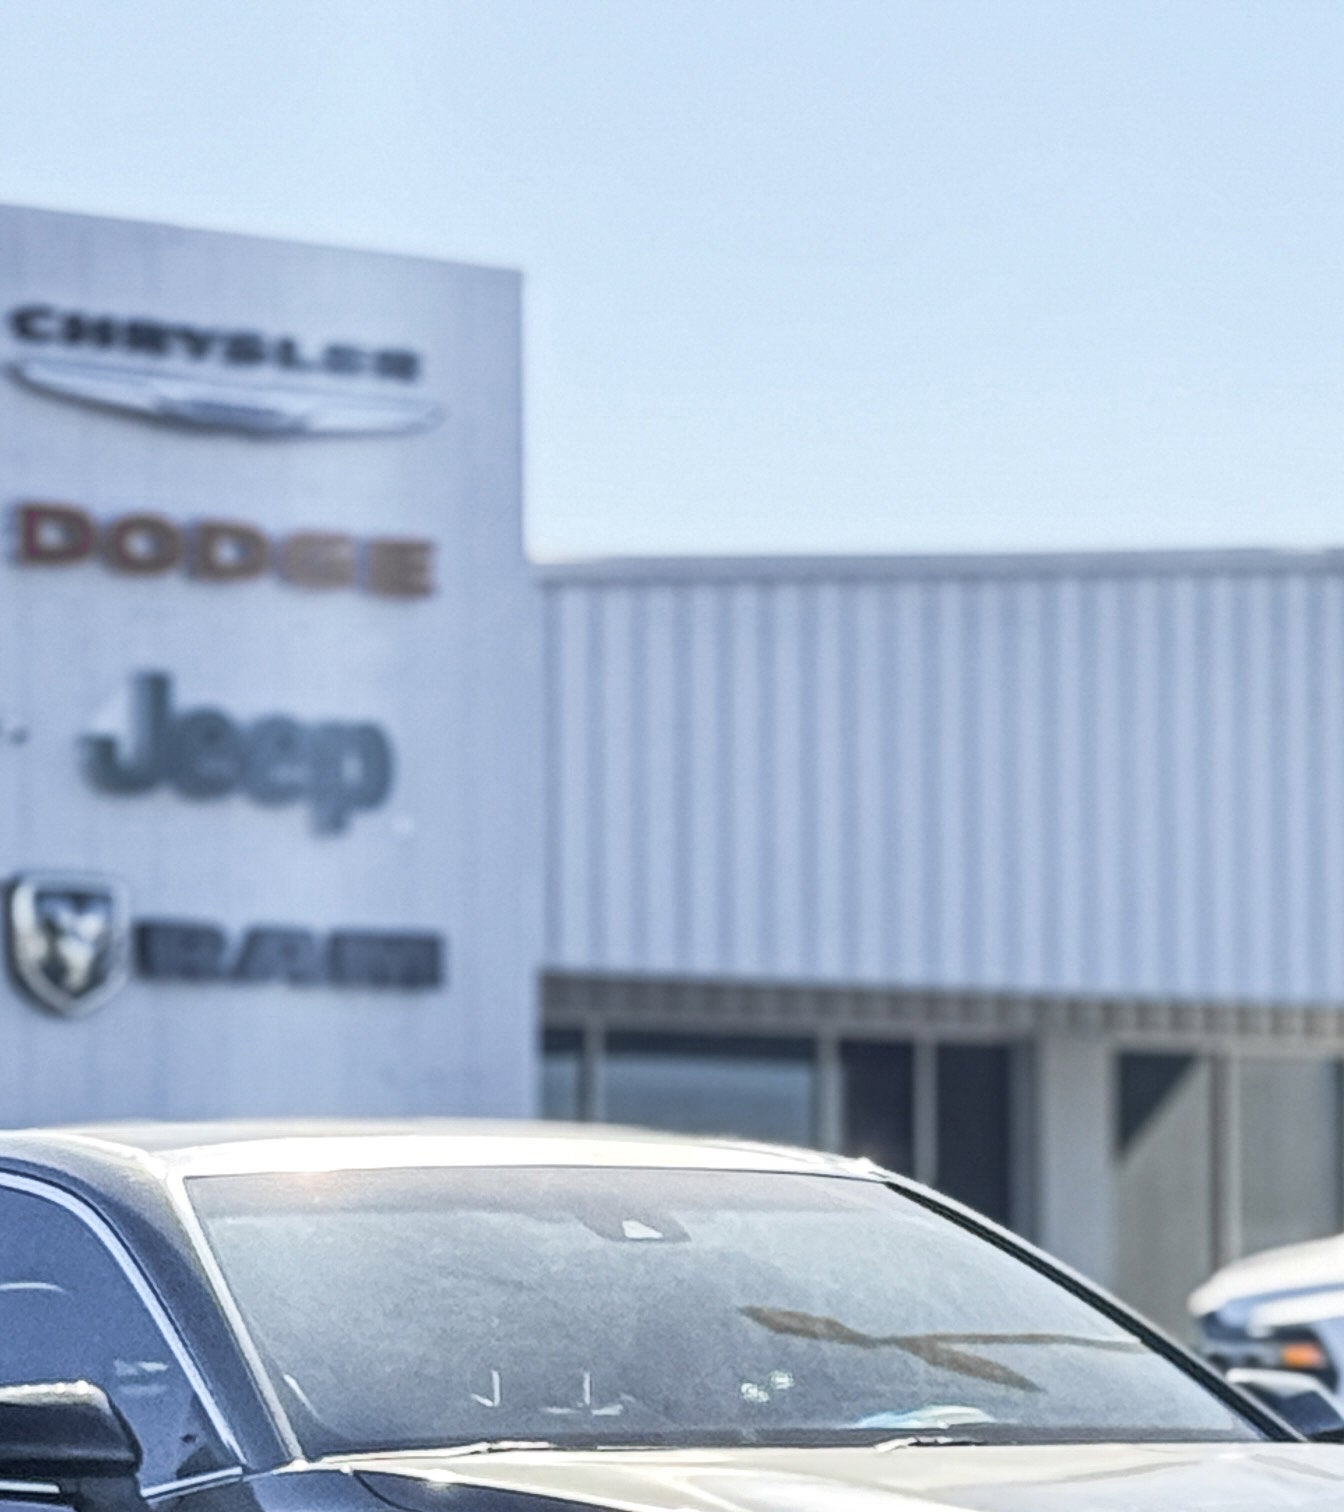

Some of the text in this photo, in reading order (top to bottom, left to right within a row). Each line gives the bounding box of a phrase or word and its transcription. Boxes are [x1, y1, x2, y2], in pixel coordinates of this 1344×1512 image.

[8, 304, 421, 383] CHRYSLER
[10, 500, 436, 600] DODGE
[79, 672, 396, 837] Jeep
[132, 918, 445, 991] RAM
